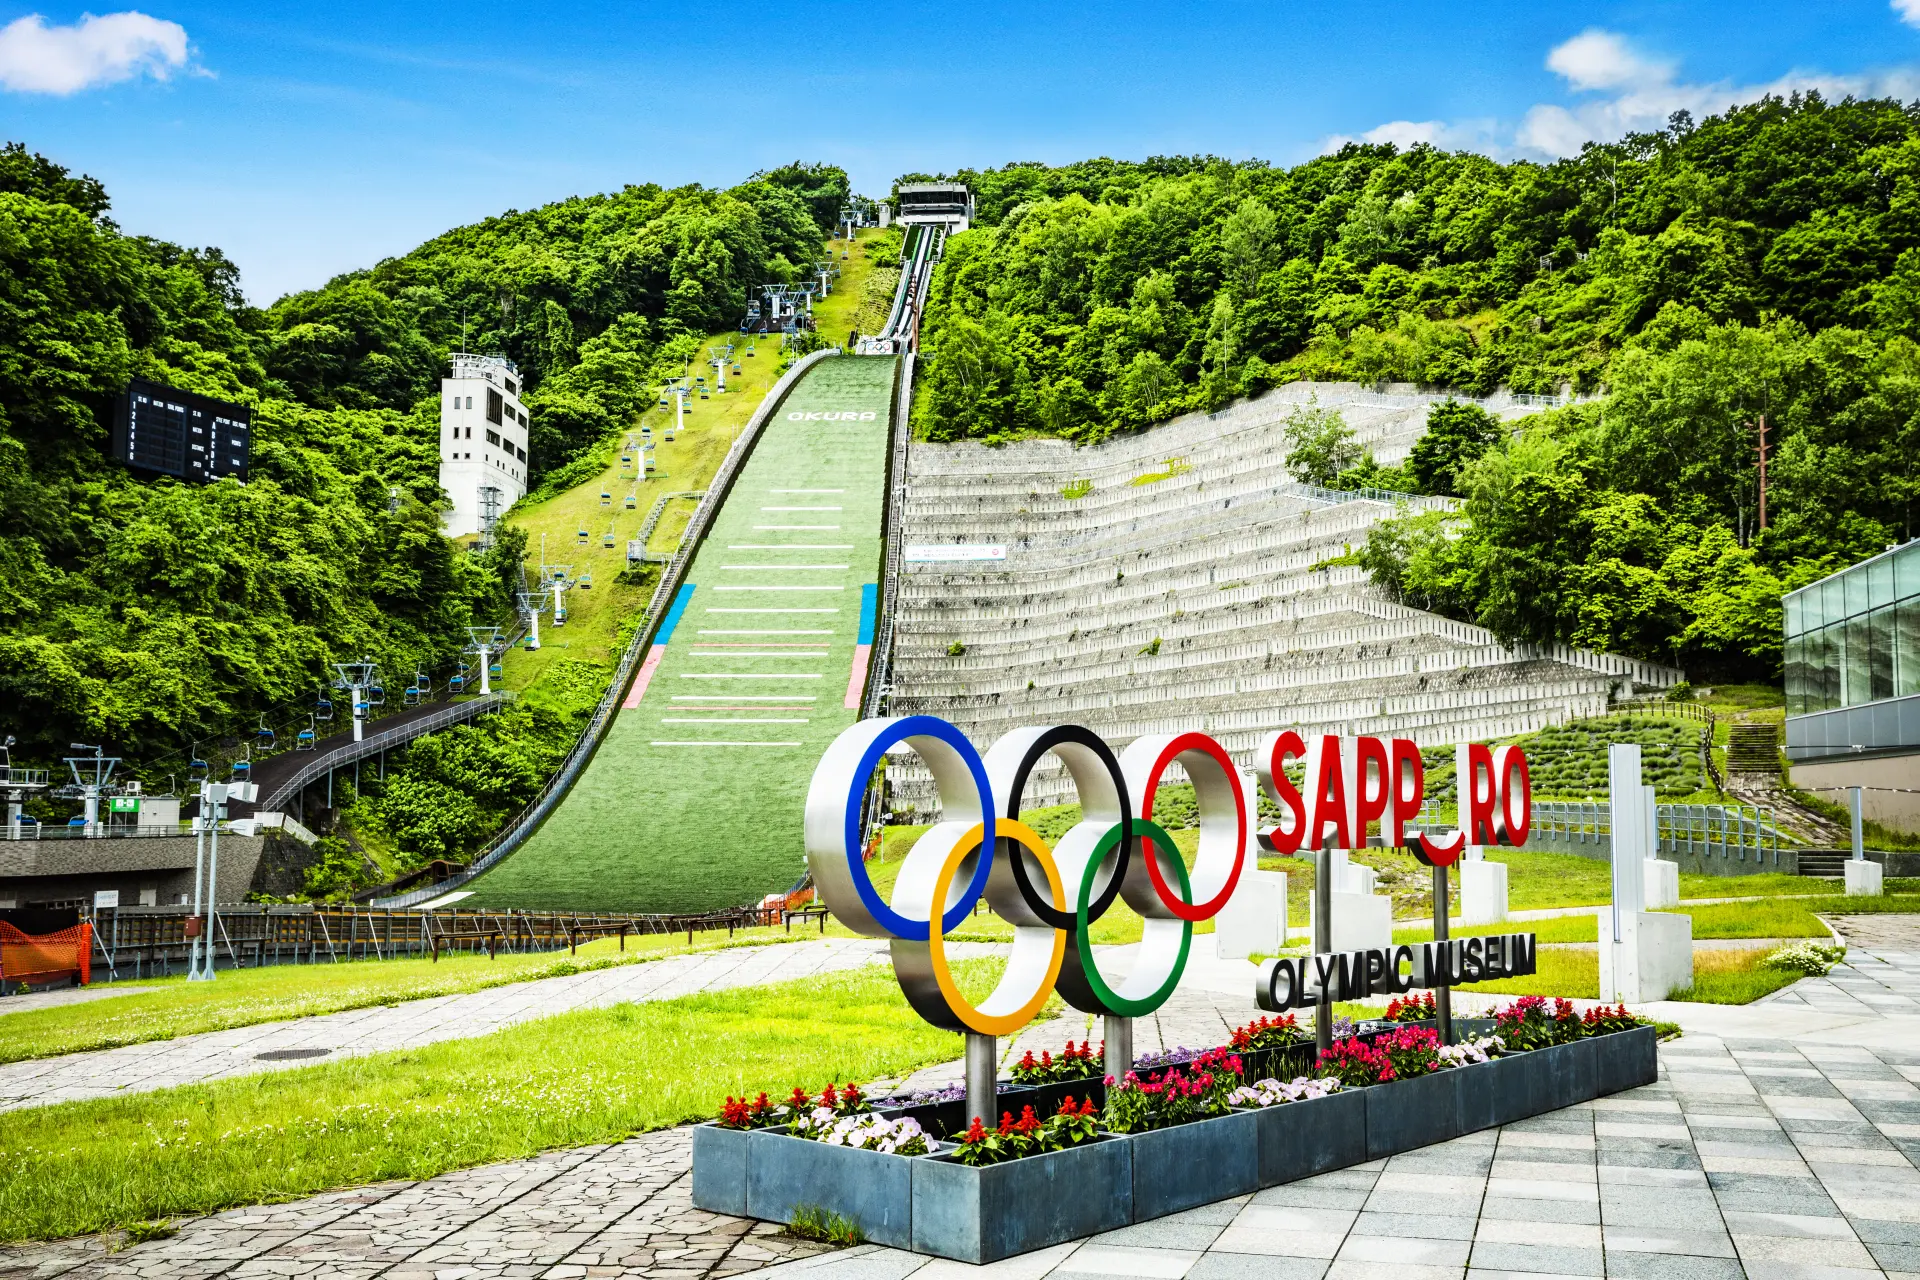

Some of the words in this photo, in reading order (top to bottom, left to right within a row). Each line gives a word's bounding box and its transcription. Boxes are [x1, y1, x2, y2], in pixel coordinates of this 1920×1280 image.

[133, 401, 136, 409] 1
[788, 412, 876, 420] OKURA
[1268, 945, 1413, 1012] OLYMPIC
[1424, 933, 1536, 988] MUSEUM
